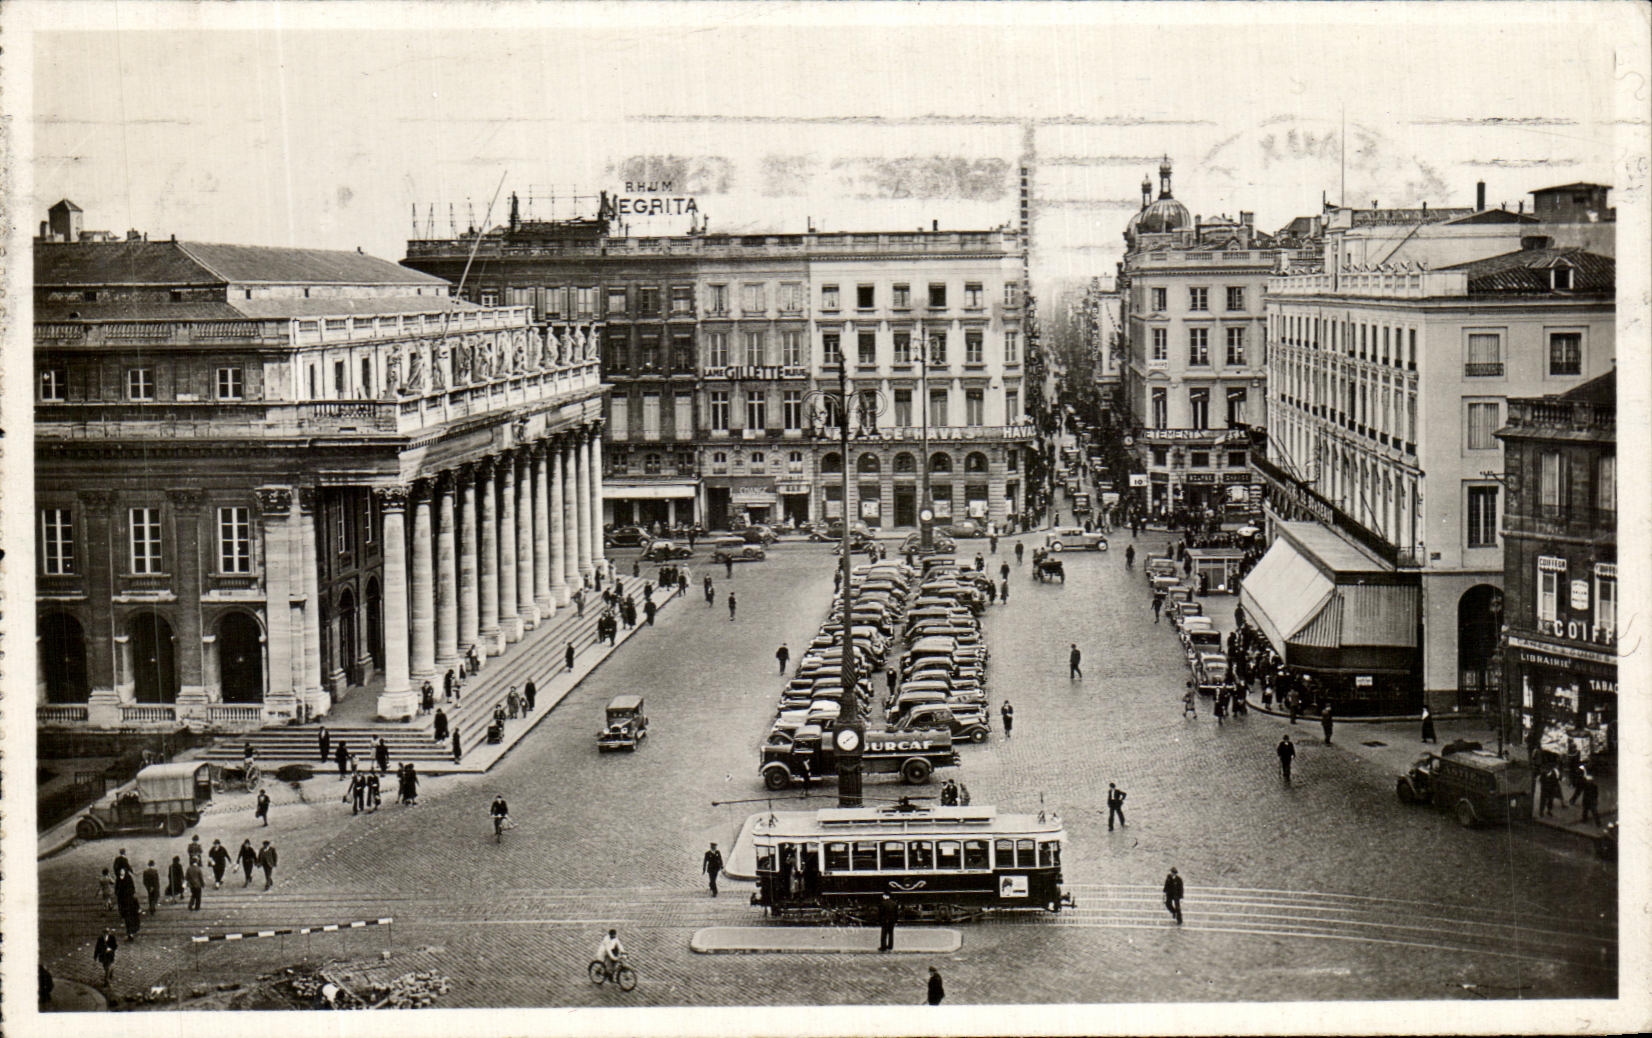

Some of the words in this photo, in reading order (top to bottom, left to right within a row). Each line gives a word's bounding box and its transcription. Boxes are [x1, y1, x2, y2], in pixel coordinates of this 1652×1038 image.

[625, 181, 673, 193] RHUM
[725, 365, 784, 380] GILLETTE
[913, 427, 976, 440] HAVAS
[1520, 652, 1569, 669] LIBRAIRIE
